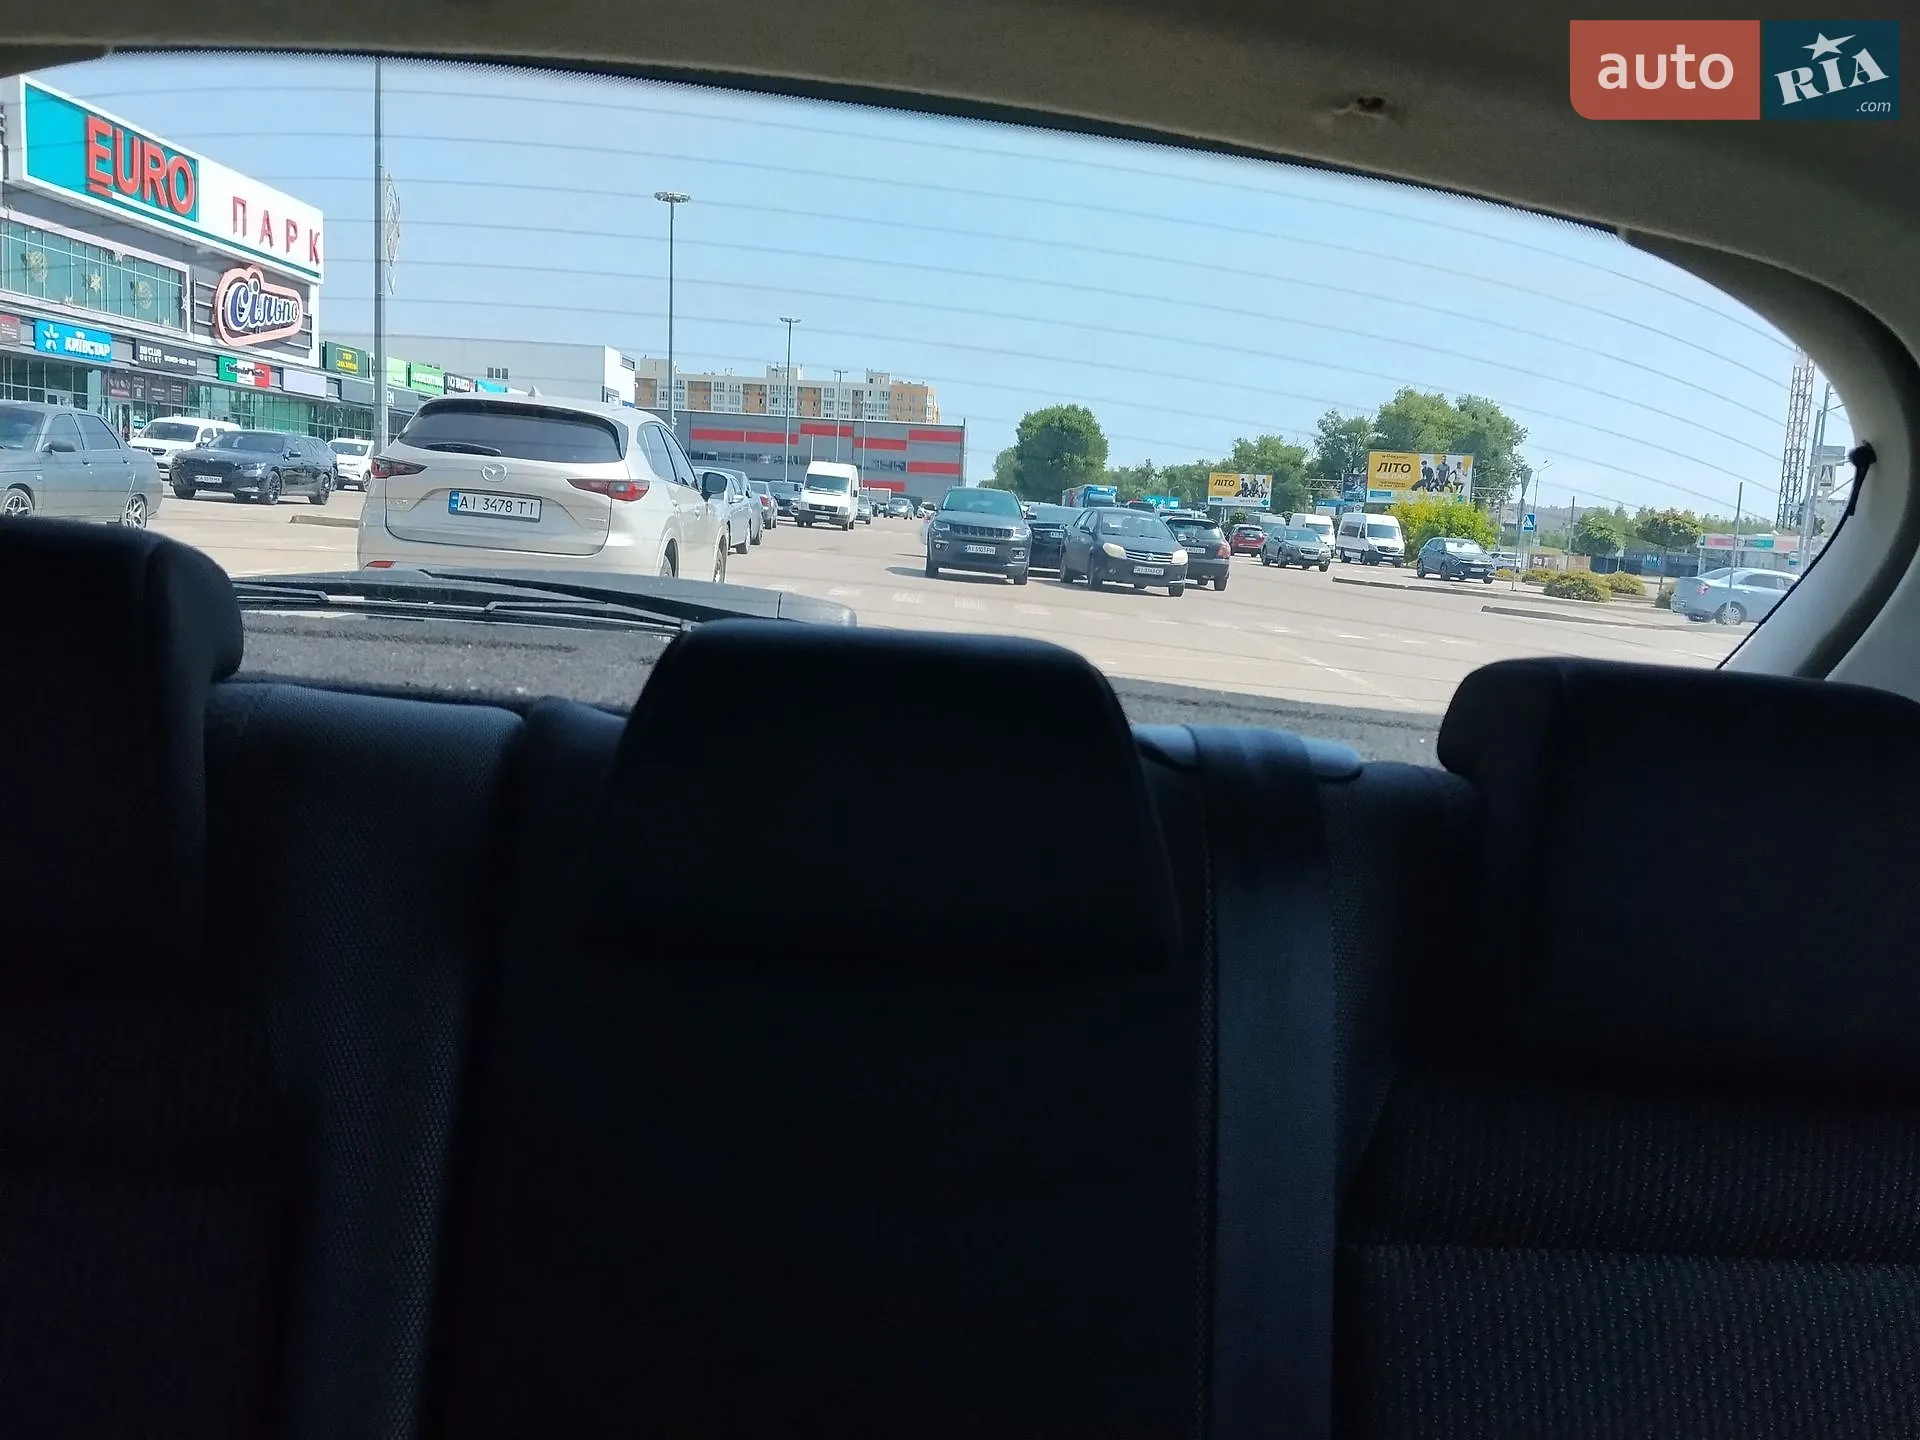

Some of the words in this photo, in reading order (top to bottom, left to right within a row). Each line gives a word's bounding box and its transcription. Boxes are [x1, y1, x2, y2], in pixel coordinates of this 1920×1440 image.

[86, 115, 196, 215] EURO
[232, 196, 321, 266] ПАРК
[226, 279, 300, 330] Сільпо
[139, 354, 162, 364] OUTLET
[1376, 462, 1412, 474] ЛІТО
[1213, 479, 1235, 487] ЛІТО
[459, 495, 476, 510] AI
[482, 497, 513, 513] 3478
[517, 501, 534, 515] TI
